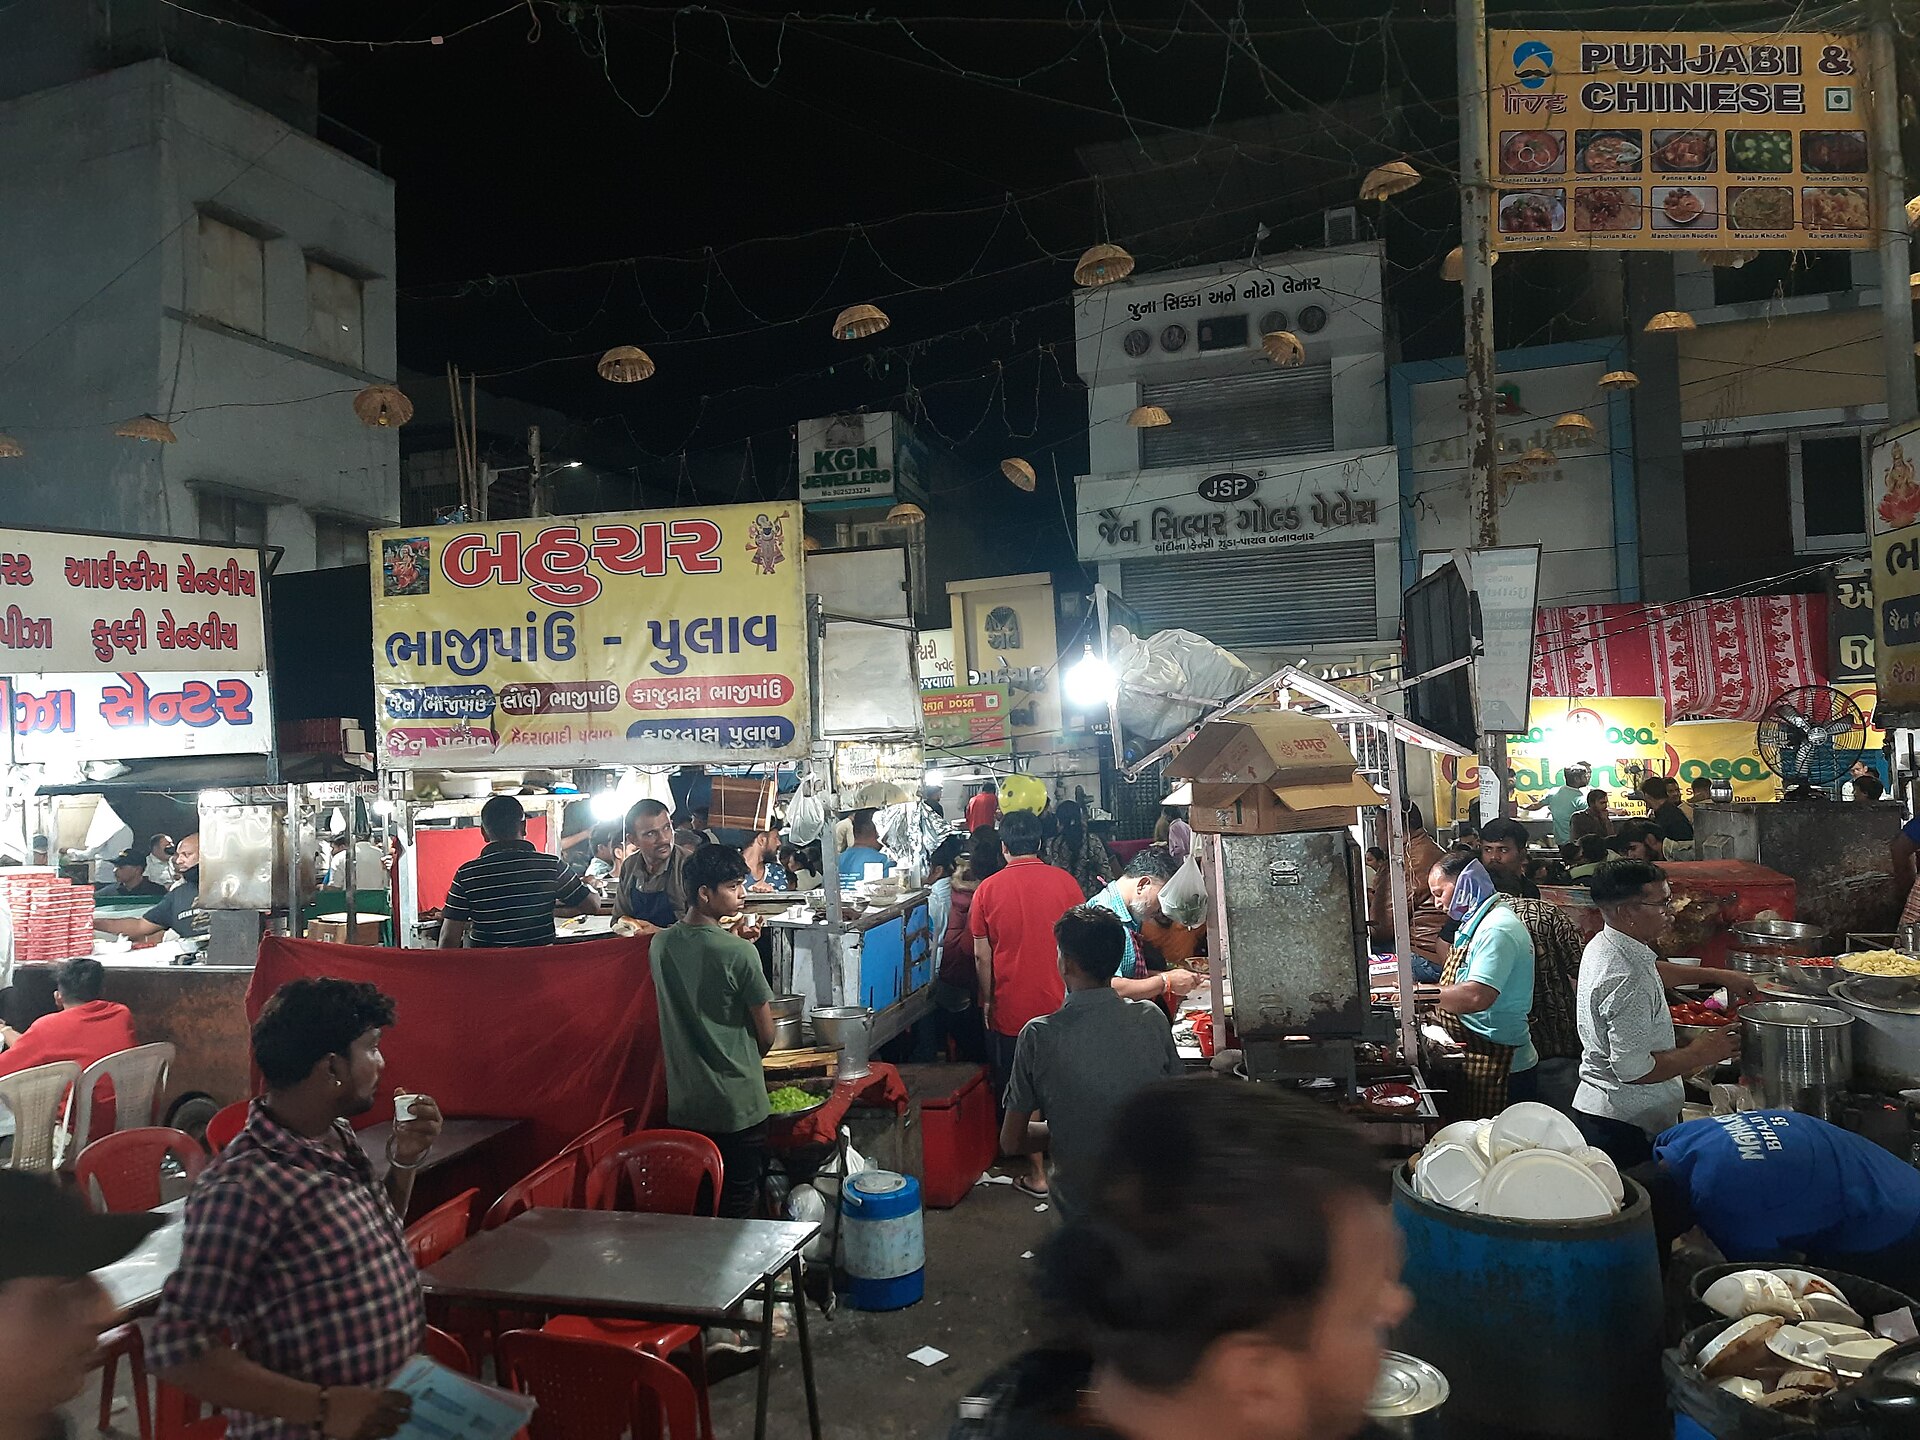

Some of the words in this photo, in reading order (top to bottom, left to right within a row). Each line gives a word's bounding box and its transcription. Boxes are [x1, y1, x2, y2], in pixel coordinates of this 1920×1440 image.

[1581, 43, 1803, 77] PUNJABI
[1817, 44, 1854, 77] &
[1581, 83, 1805, 115] CHINESE
[1127, 300, 1157, 321] જુના
[1163, 292, 1201, 312] સિક્કા
[1208, 284, 1236, 304] અને
[1243, 279, 1275, 300] નોટો
[1282, 275, 1321, 294] લેનાર
[814, 446, 877, 473] KGN
[1206, 478, 1248, 498] JSP
[1098, 506, 1141, 545] જૈન
[1151, 506, 1228, 541] સિલ્વર
[1236, 499, 1301, 534] ગોલ્ડ
[1309, 489, 1377, 529] પેલેસ
[177, 553, 256, 597] સેન્ડવીચ
[441, 517, 723, 608] બહુચર
[91, 608, 148, 663] કુલ્ફી
[157, 609, 239, 650] સેન્ડવીચ
[384, 609, 578, 677] ભાજીપાંઉ
[647, 613, 779, 675] પુલાવ
[99, 671, 253, 728] સેન્ટર
[549, 682, 619, 711] ભાજીપાંઉ
[709, 677, 782, 704] ભાજીપાંઉ
[949, 698, 974, 709] DOSA
[1605, 726, 1659, 746] osa
